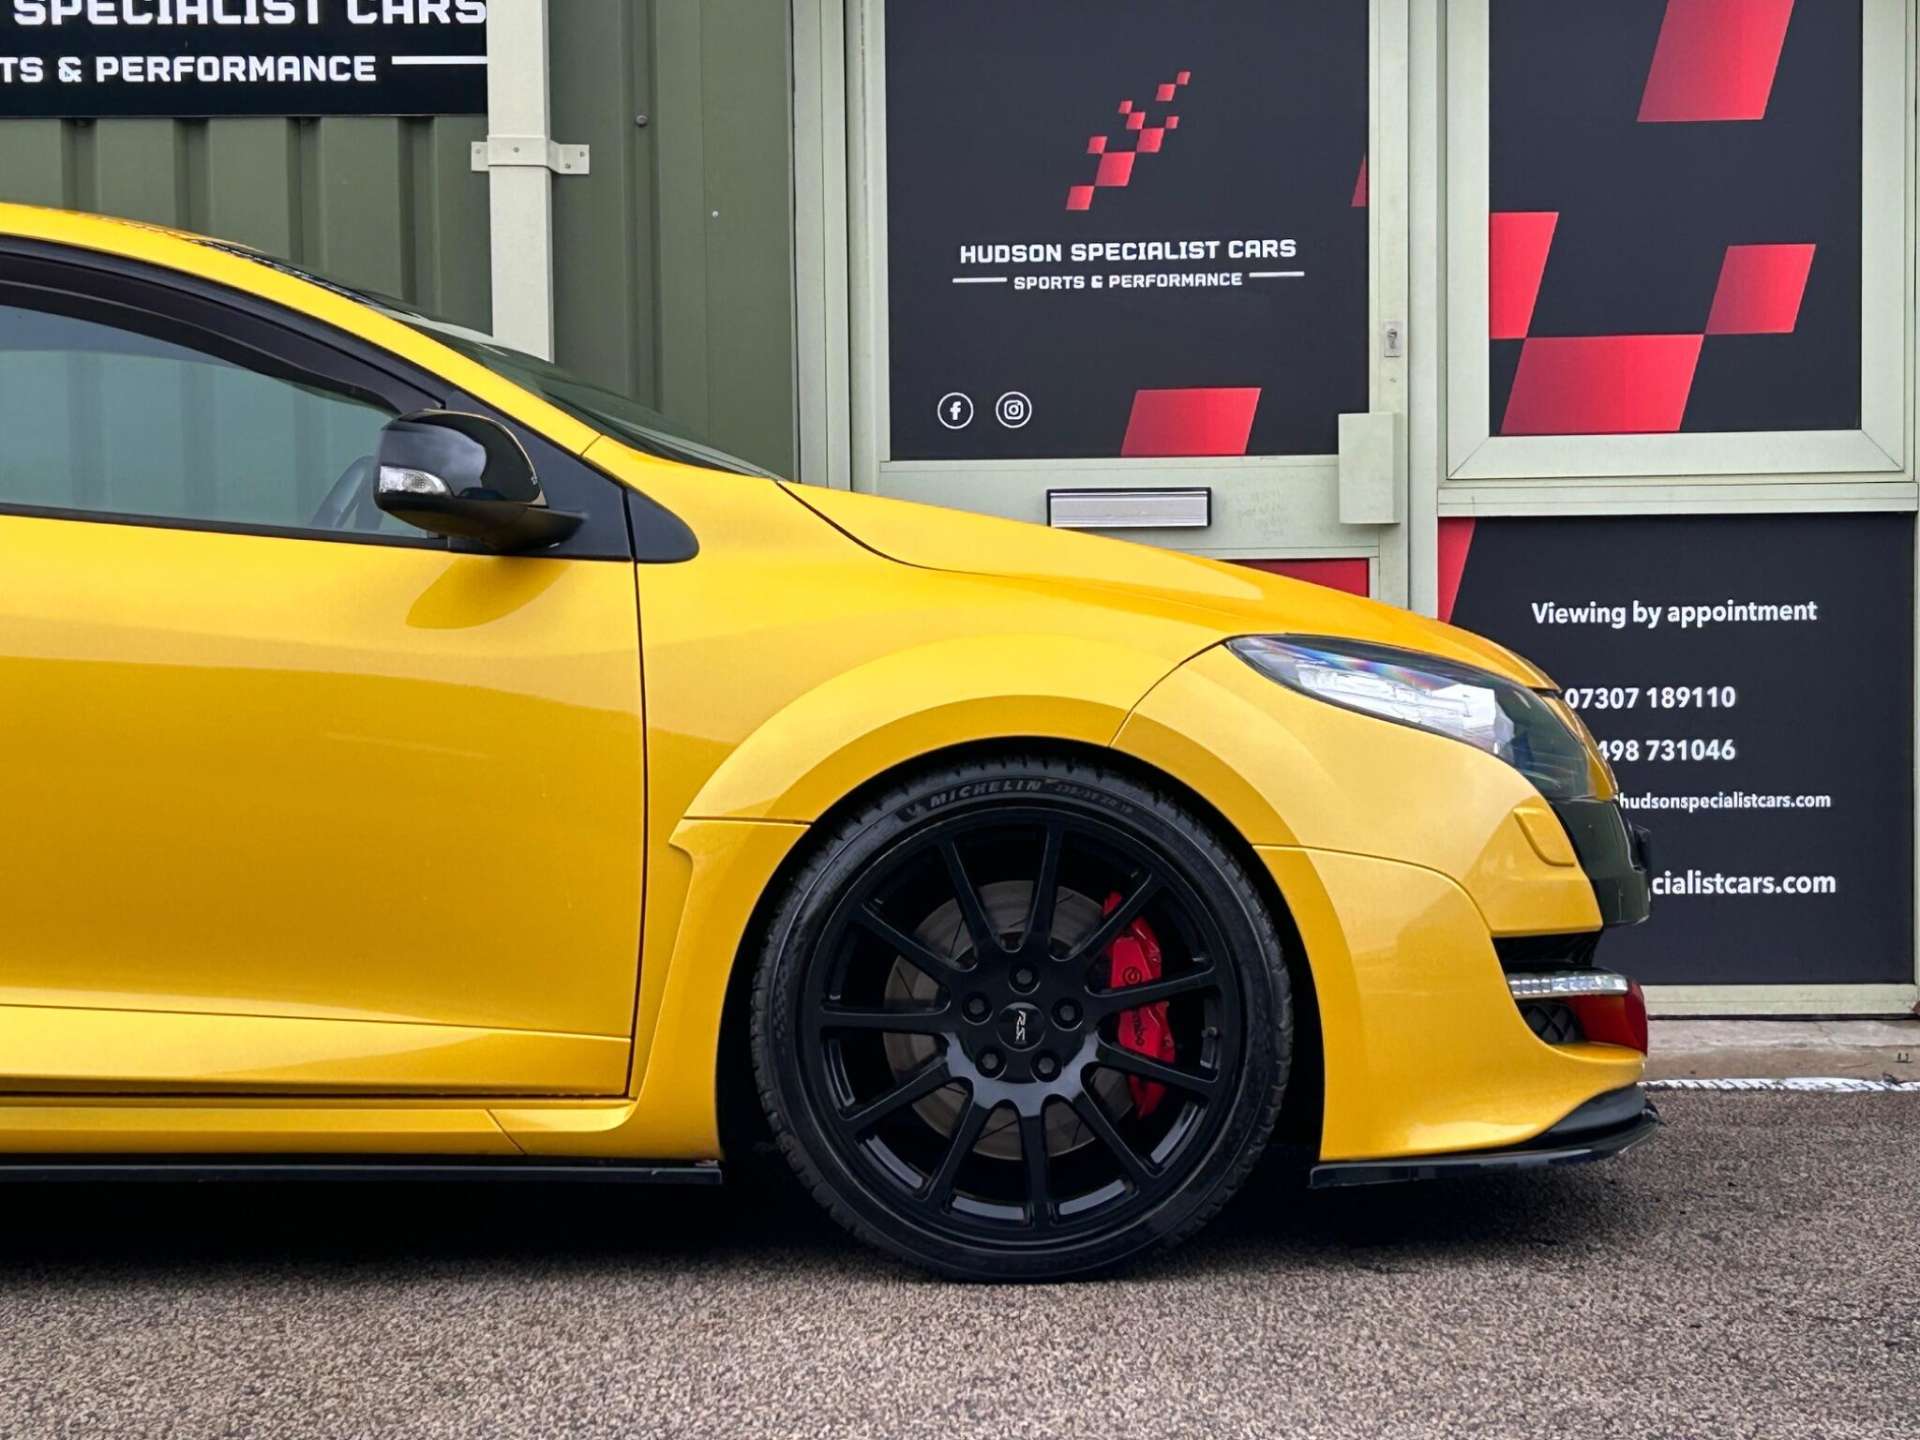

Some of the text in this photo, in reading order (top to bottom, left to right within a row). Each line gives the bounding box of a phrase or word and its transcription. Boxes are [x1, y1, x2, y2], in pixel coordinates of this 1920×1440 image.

[346, 0, 487, 25] CARS
[0, 56, 376, 82] TS & PERFORMANCE
[961, 239, 1296, 263] HUDSON SPECIALIST CARS
[1014, 272, 1242, 290] SPORTS & PERFORMANCE
[1532, 599, 1818, 629] Viewing by appointment
[1564, 686, 1736, 709] 07307 189110
[1646, 739, 1736, 761] 731046
[930, 779, 1042, 808] MICHELIN
[1616, 791, 1831, 813] hudsonspecialistcars.com
[1652, 870, 1836, 895] cialistcars.com
